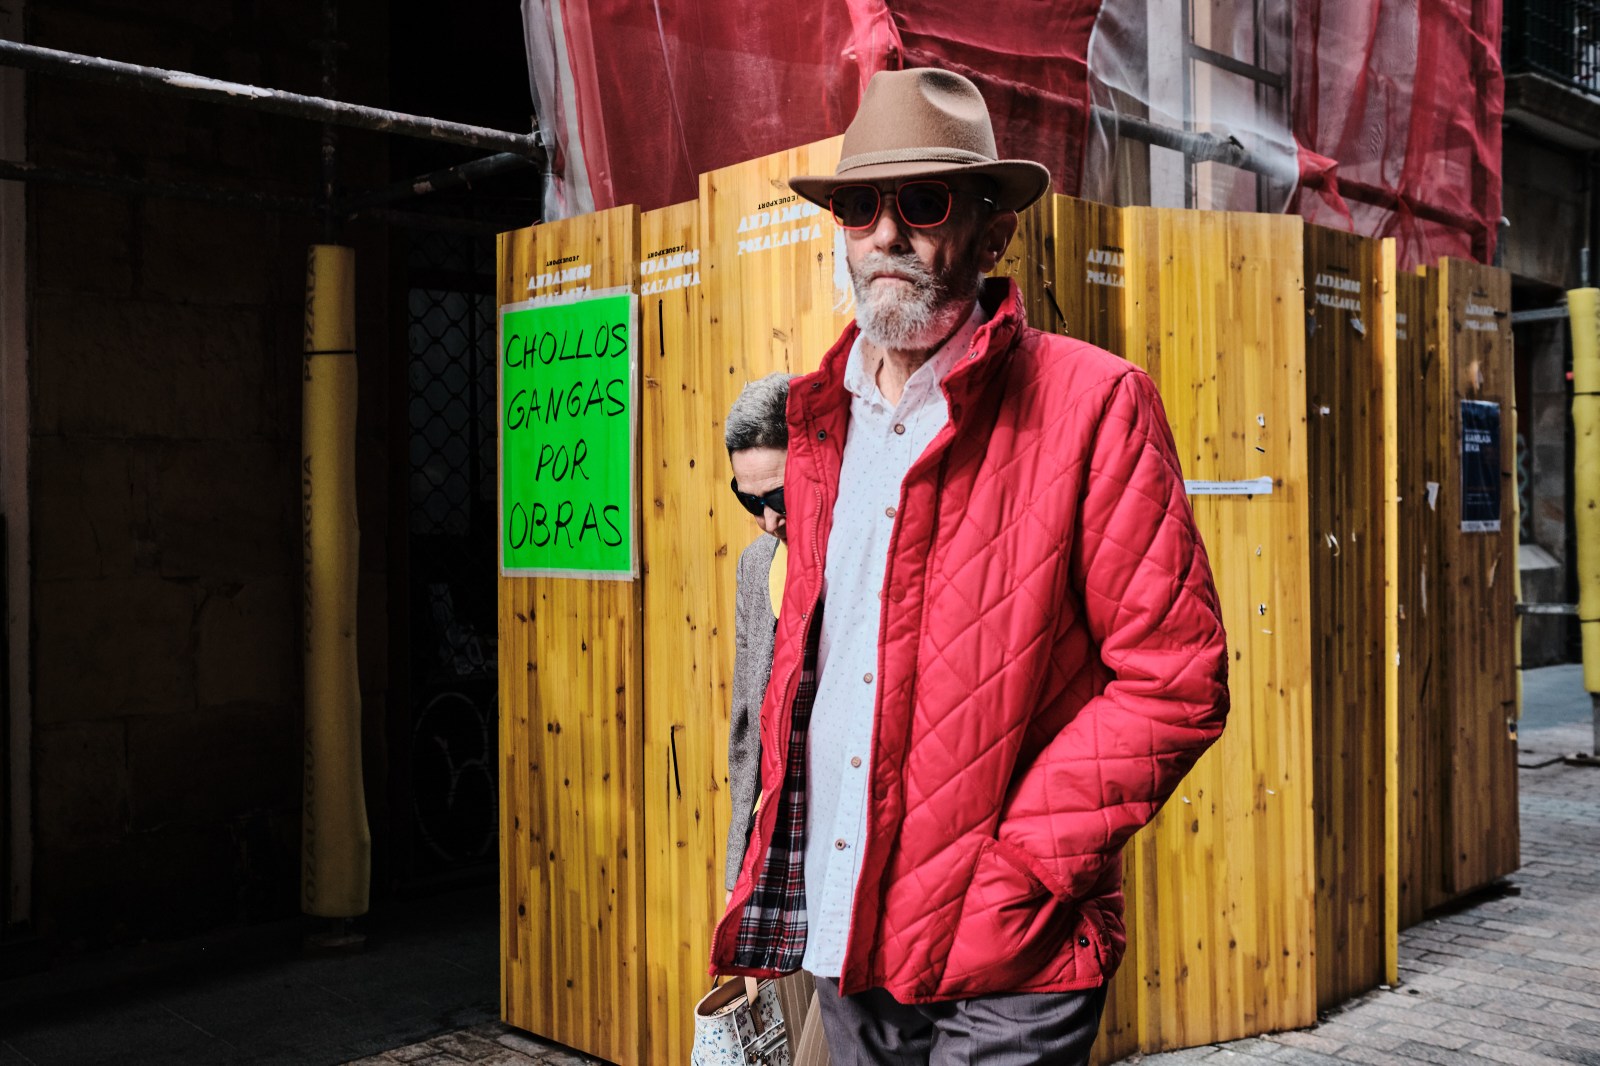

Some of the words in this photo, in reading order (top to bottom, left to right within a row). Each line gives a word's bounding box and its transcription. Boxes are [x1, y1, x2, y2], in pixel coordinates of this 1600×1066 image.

[505, 321, 628, 370] CHOLLOS
[507, 378, 626, 430] GANGAS
[535, 438, 590, 482] POR
[508, 500, 624, 550] OBRAS
